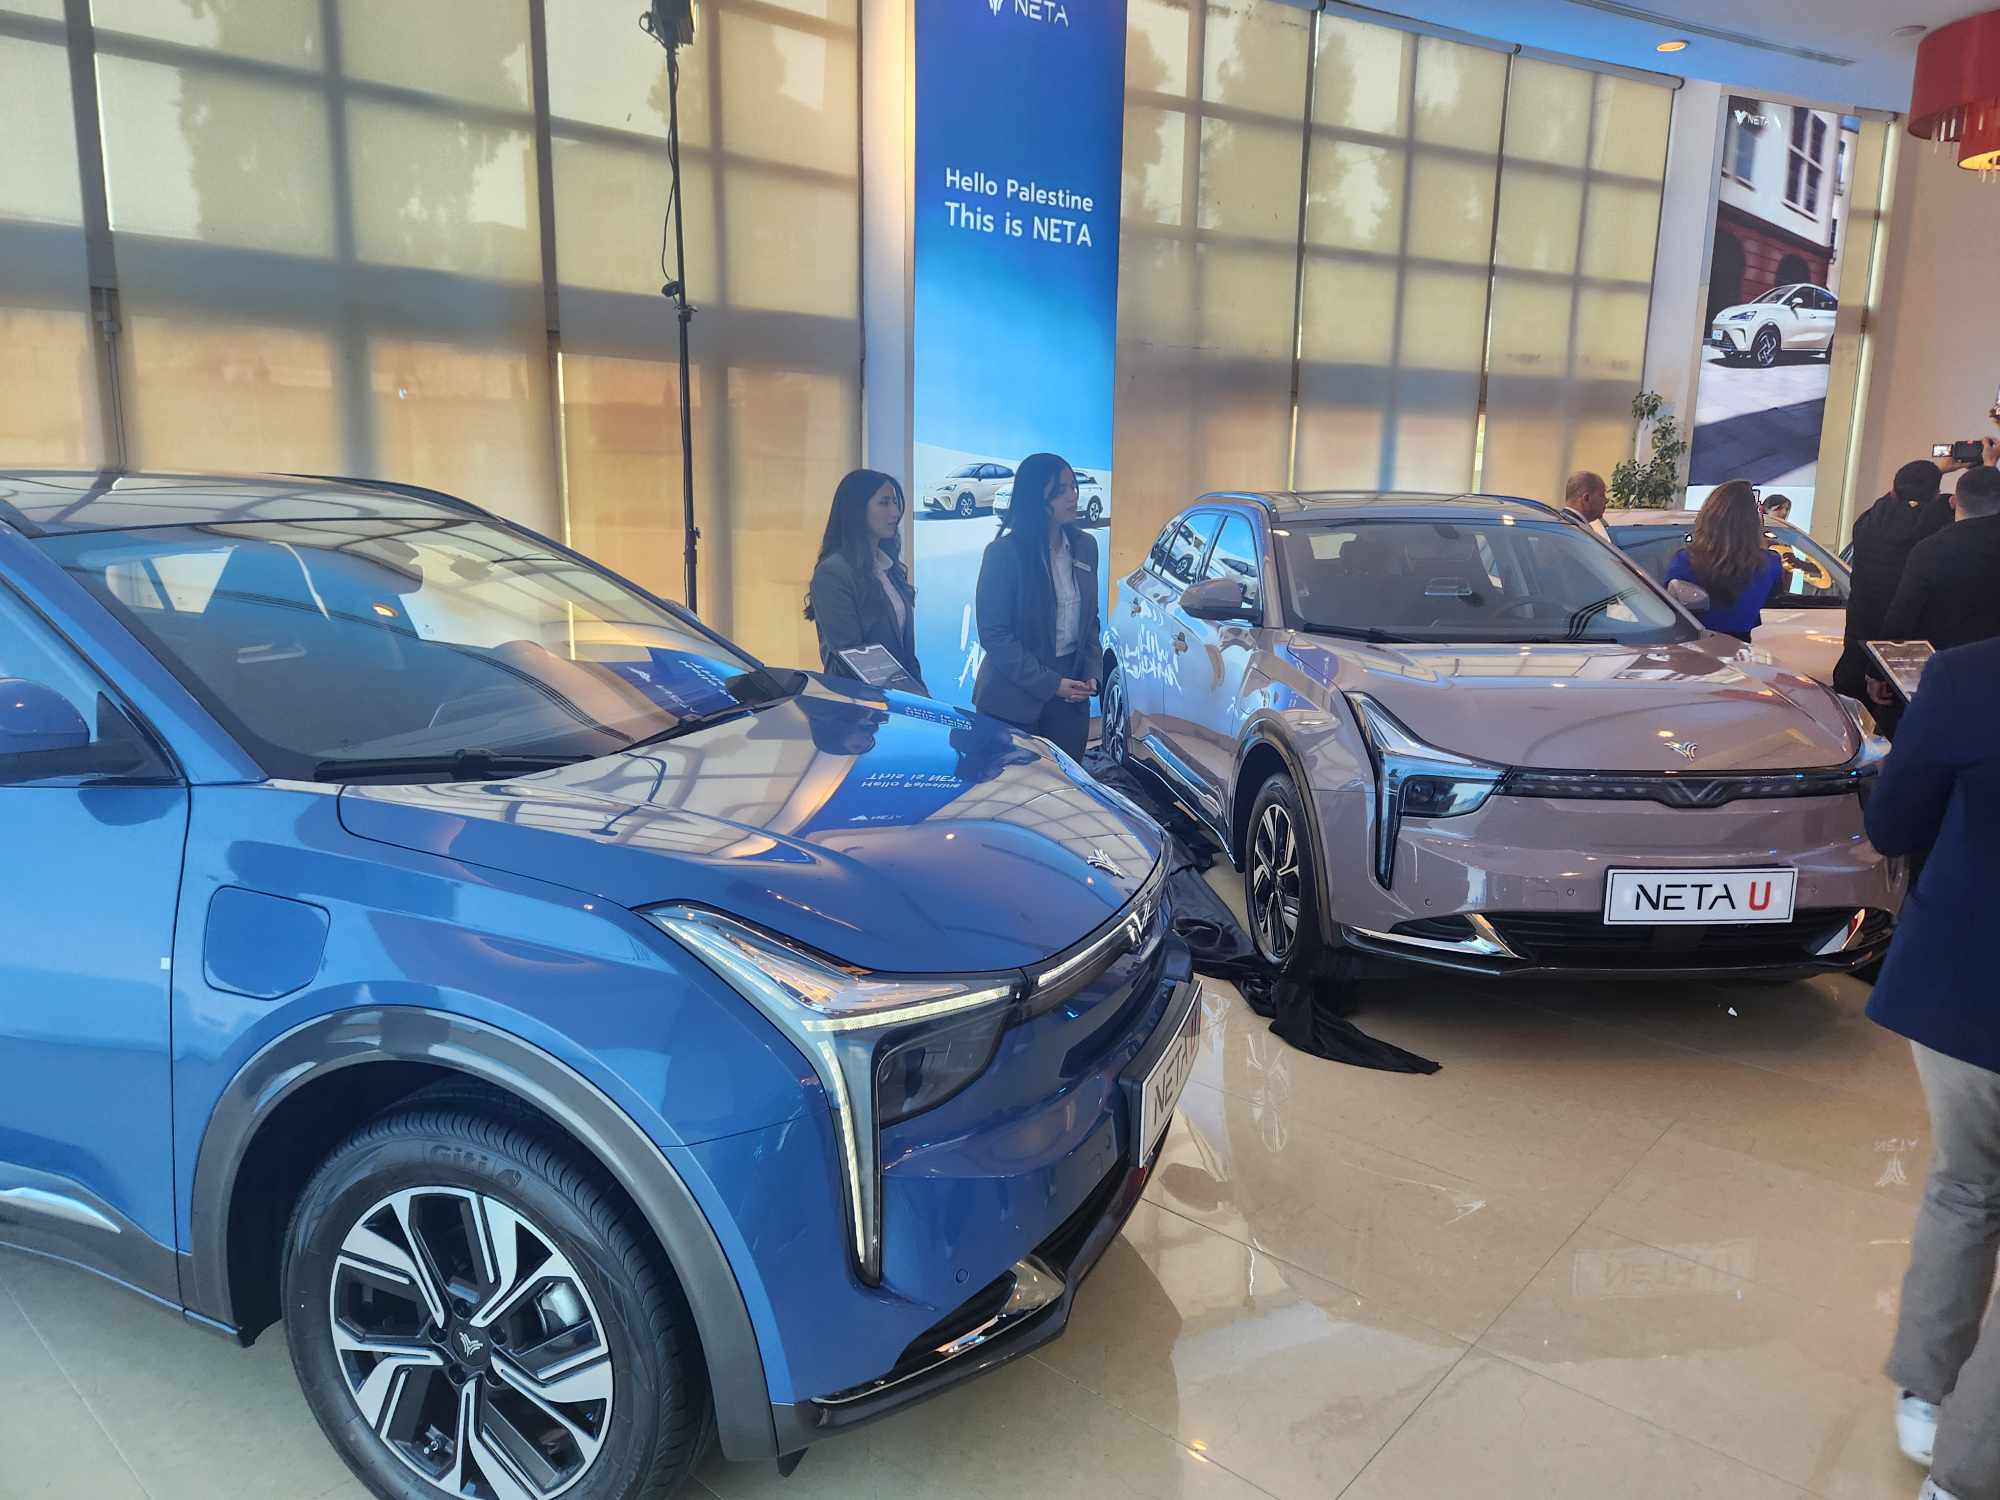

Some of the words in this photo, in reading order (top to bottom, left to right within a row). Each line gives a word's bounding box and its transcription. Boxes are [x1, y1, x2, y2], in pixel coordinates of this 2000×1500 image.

[1014, 0, 1069, 28] NETA
[945, 167, 998, 196] Hello
[1006, 178, 1094, 212] Palestine
[944, 201, 994, 233] This
[1004, 211, 1023, 238] is
[1033, 216, 1093, 248] NETA
[1635, 883, 1737, 911] NETA
[1748, 881, 1772, 911] U
[1153, 1034, 1188, 1126] NETA
